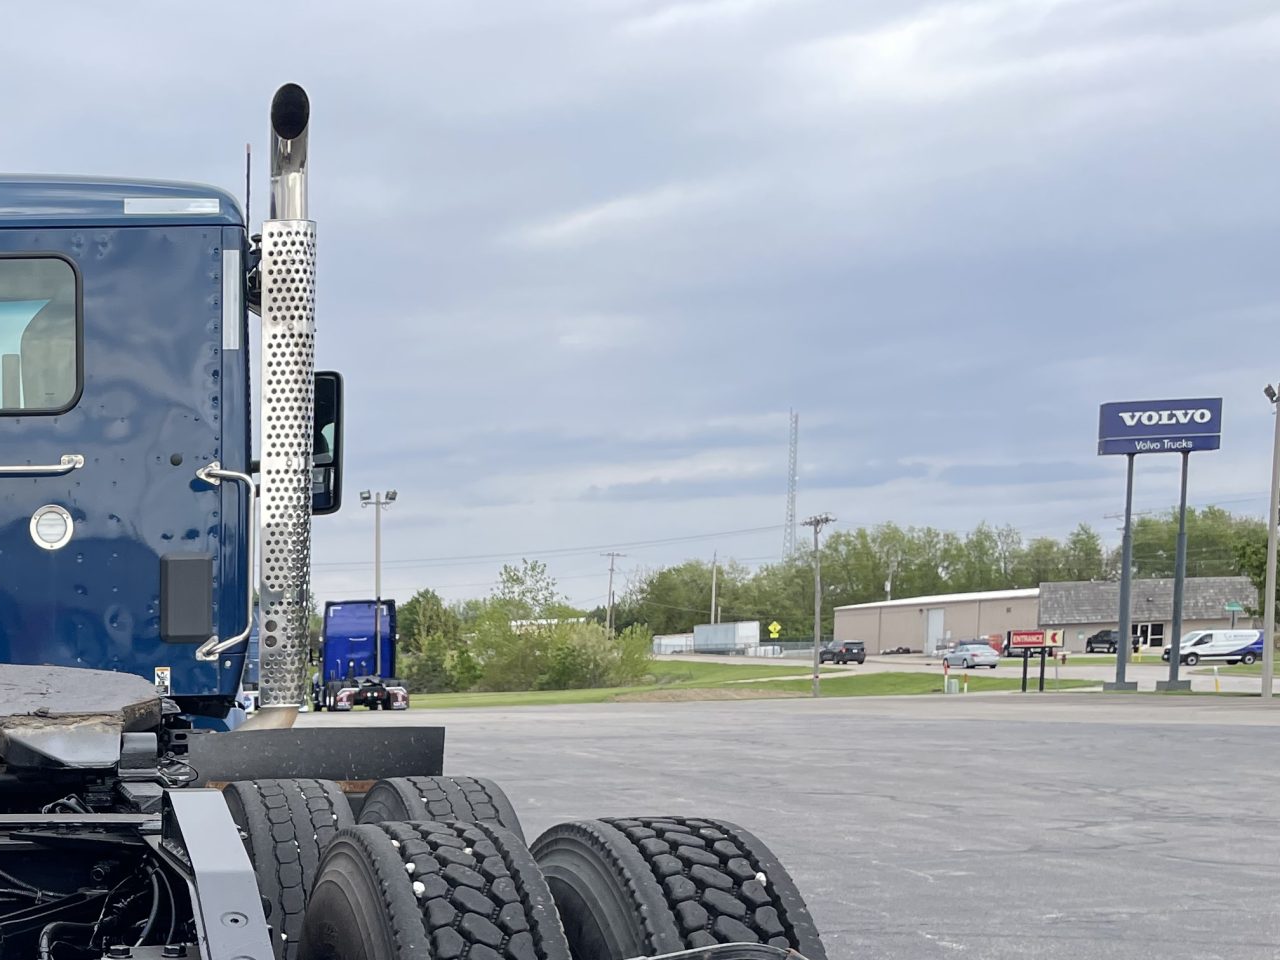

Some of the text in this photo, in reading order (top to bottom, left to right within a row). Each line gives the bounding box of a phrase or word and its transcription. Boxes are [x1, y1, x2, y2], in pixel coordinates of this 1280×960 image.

[1119, 409, 1212, 426] VOLVO
[1135, 439, 1193, 451] Volvo Trucks
